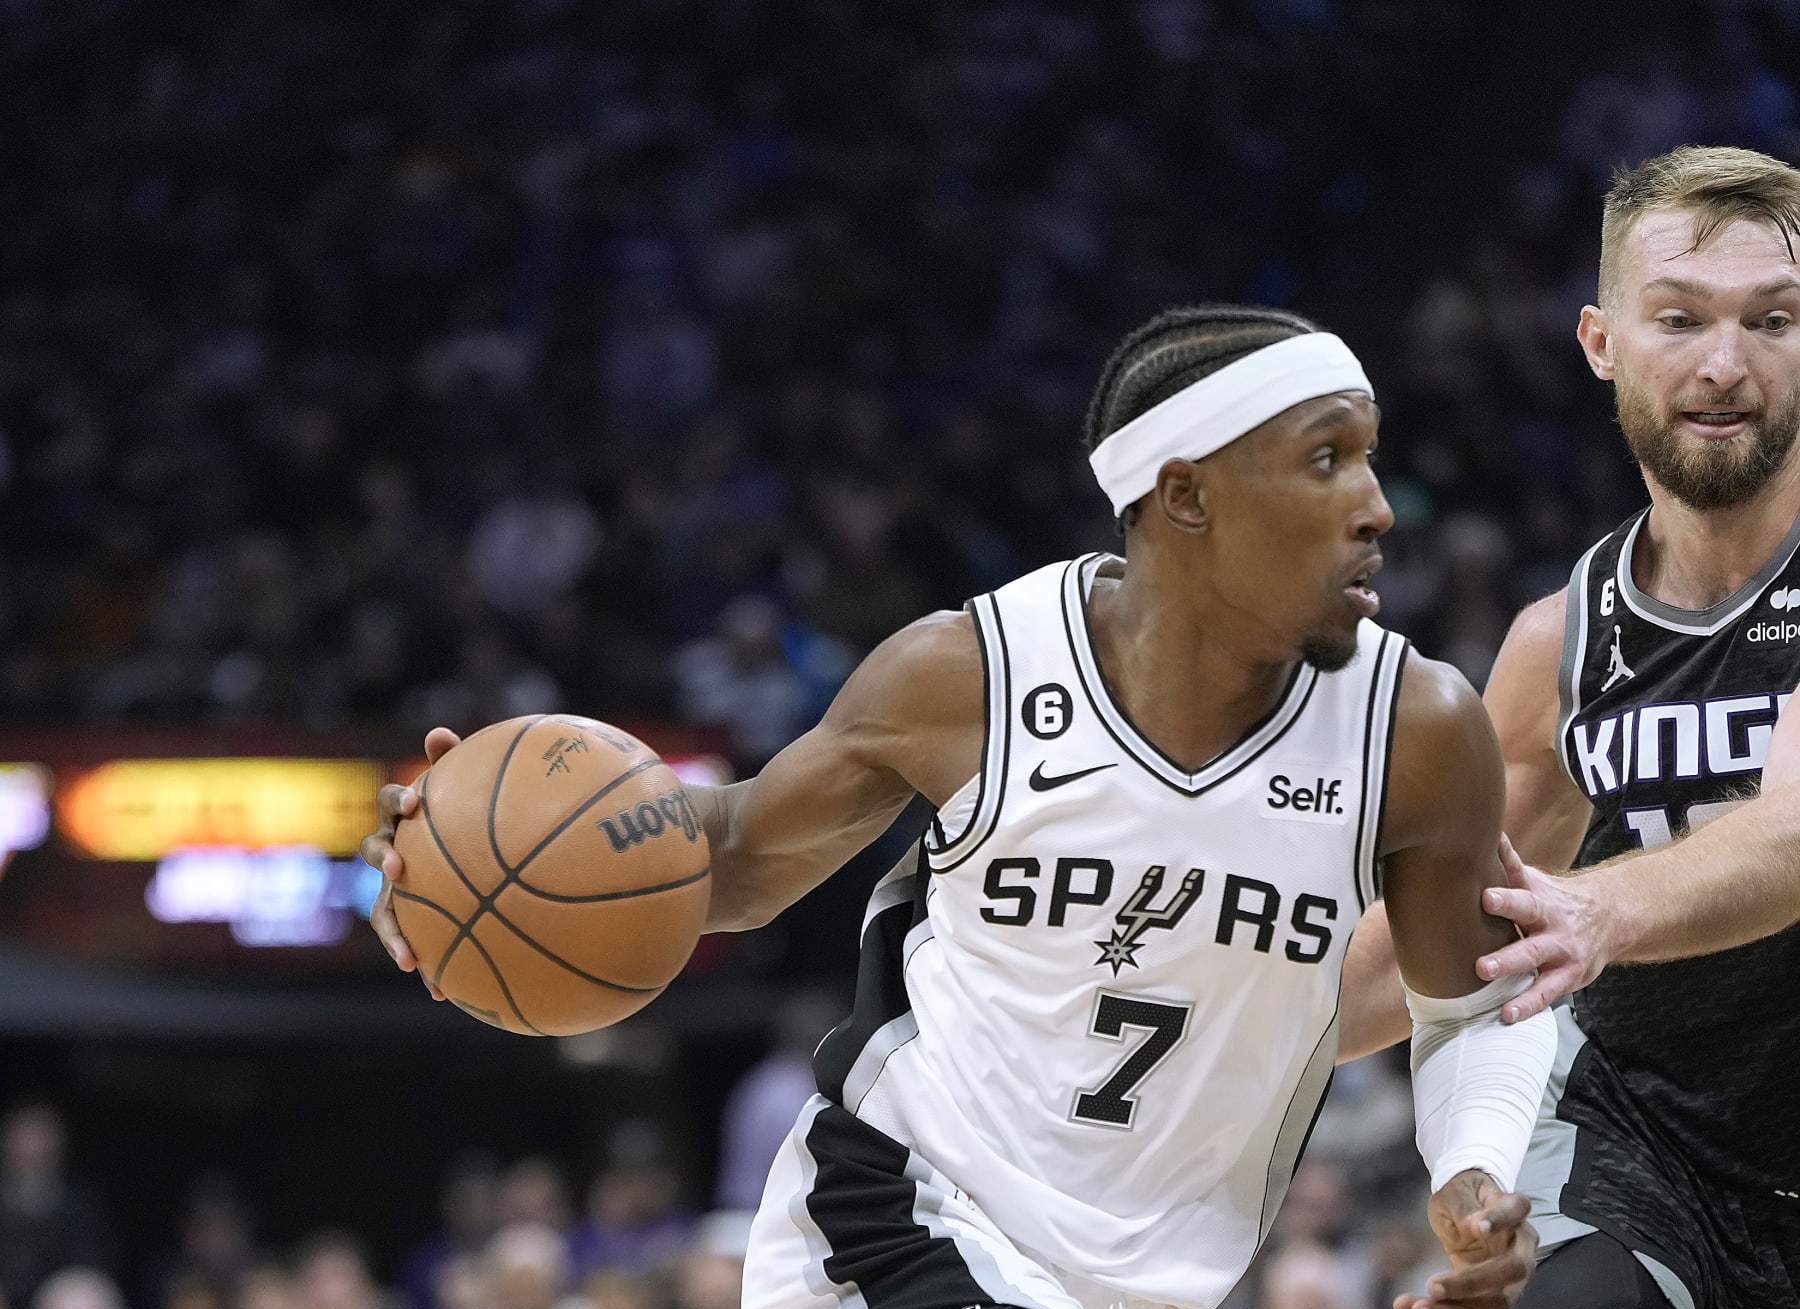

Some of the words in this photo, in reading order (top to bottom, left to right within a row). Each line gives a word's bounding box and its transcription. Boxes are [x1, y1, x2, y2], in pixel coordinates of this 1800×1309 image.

[1599, 577, 1615, 617] 6
[1746, 620, 1800, 645] dialp
[1033, 689, 1065, 736] 6
[1572, 690, 1793, 799] KING
[596, 788, 703, 854] lson
[1266, 774, 1344, 815] Self.
[979, 856, 1338, 979] SPURS
[1067, 986, 1196, 1132] 7
